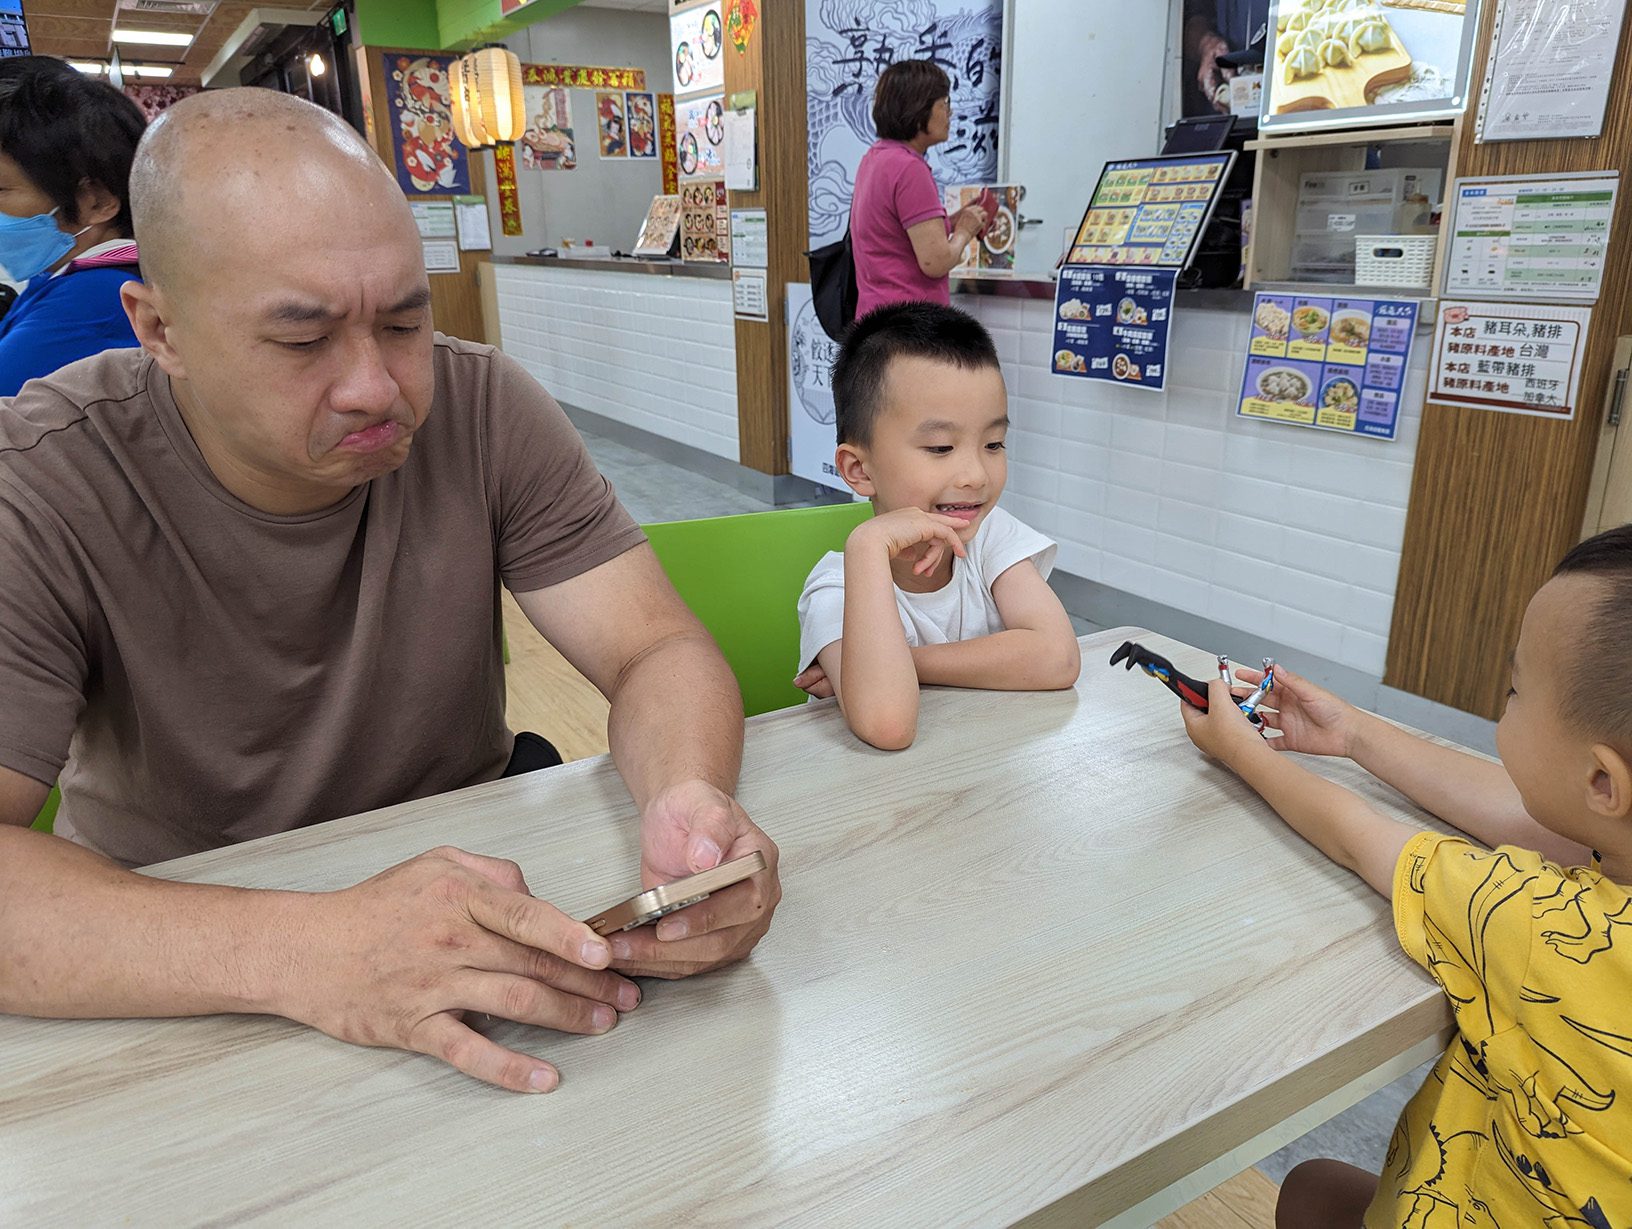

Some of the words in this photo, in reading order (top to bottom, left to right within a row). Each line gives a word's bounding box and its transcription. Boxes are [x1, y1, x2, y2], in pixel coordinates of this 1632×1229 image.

[1450, 326, 1477, 340] 本店
[1447, 342, 1515, 358] 豬原料產地
[1519, 343, 1549, 359] 台灣
[1444, 361, 1471, 375] 本店
[1476, 359, 1536, 377] 藍帶豬排
[1443, 376, 1510, 394] 豬原料產地
[1524, 377, 1560, 391] 西班牙
[1523, 391, 1558, 405] 加拿大
